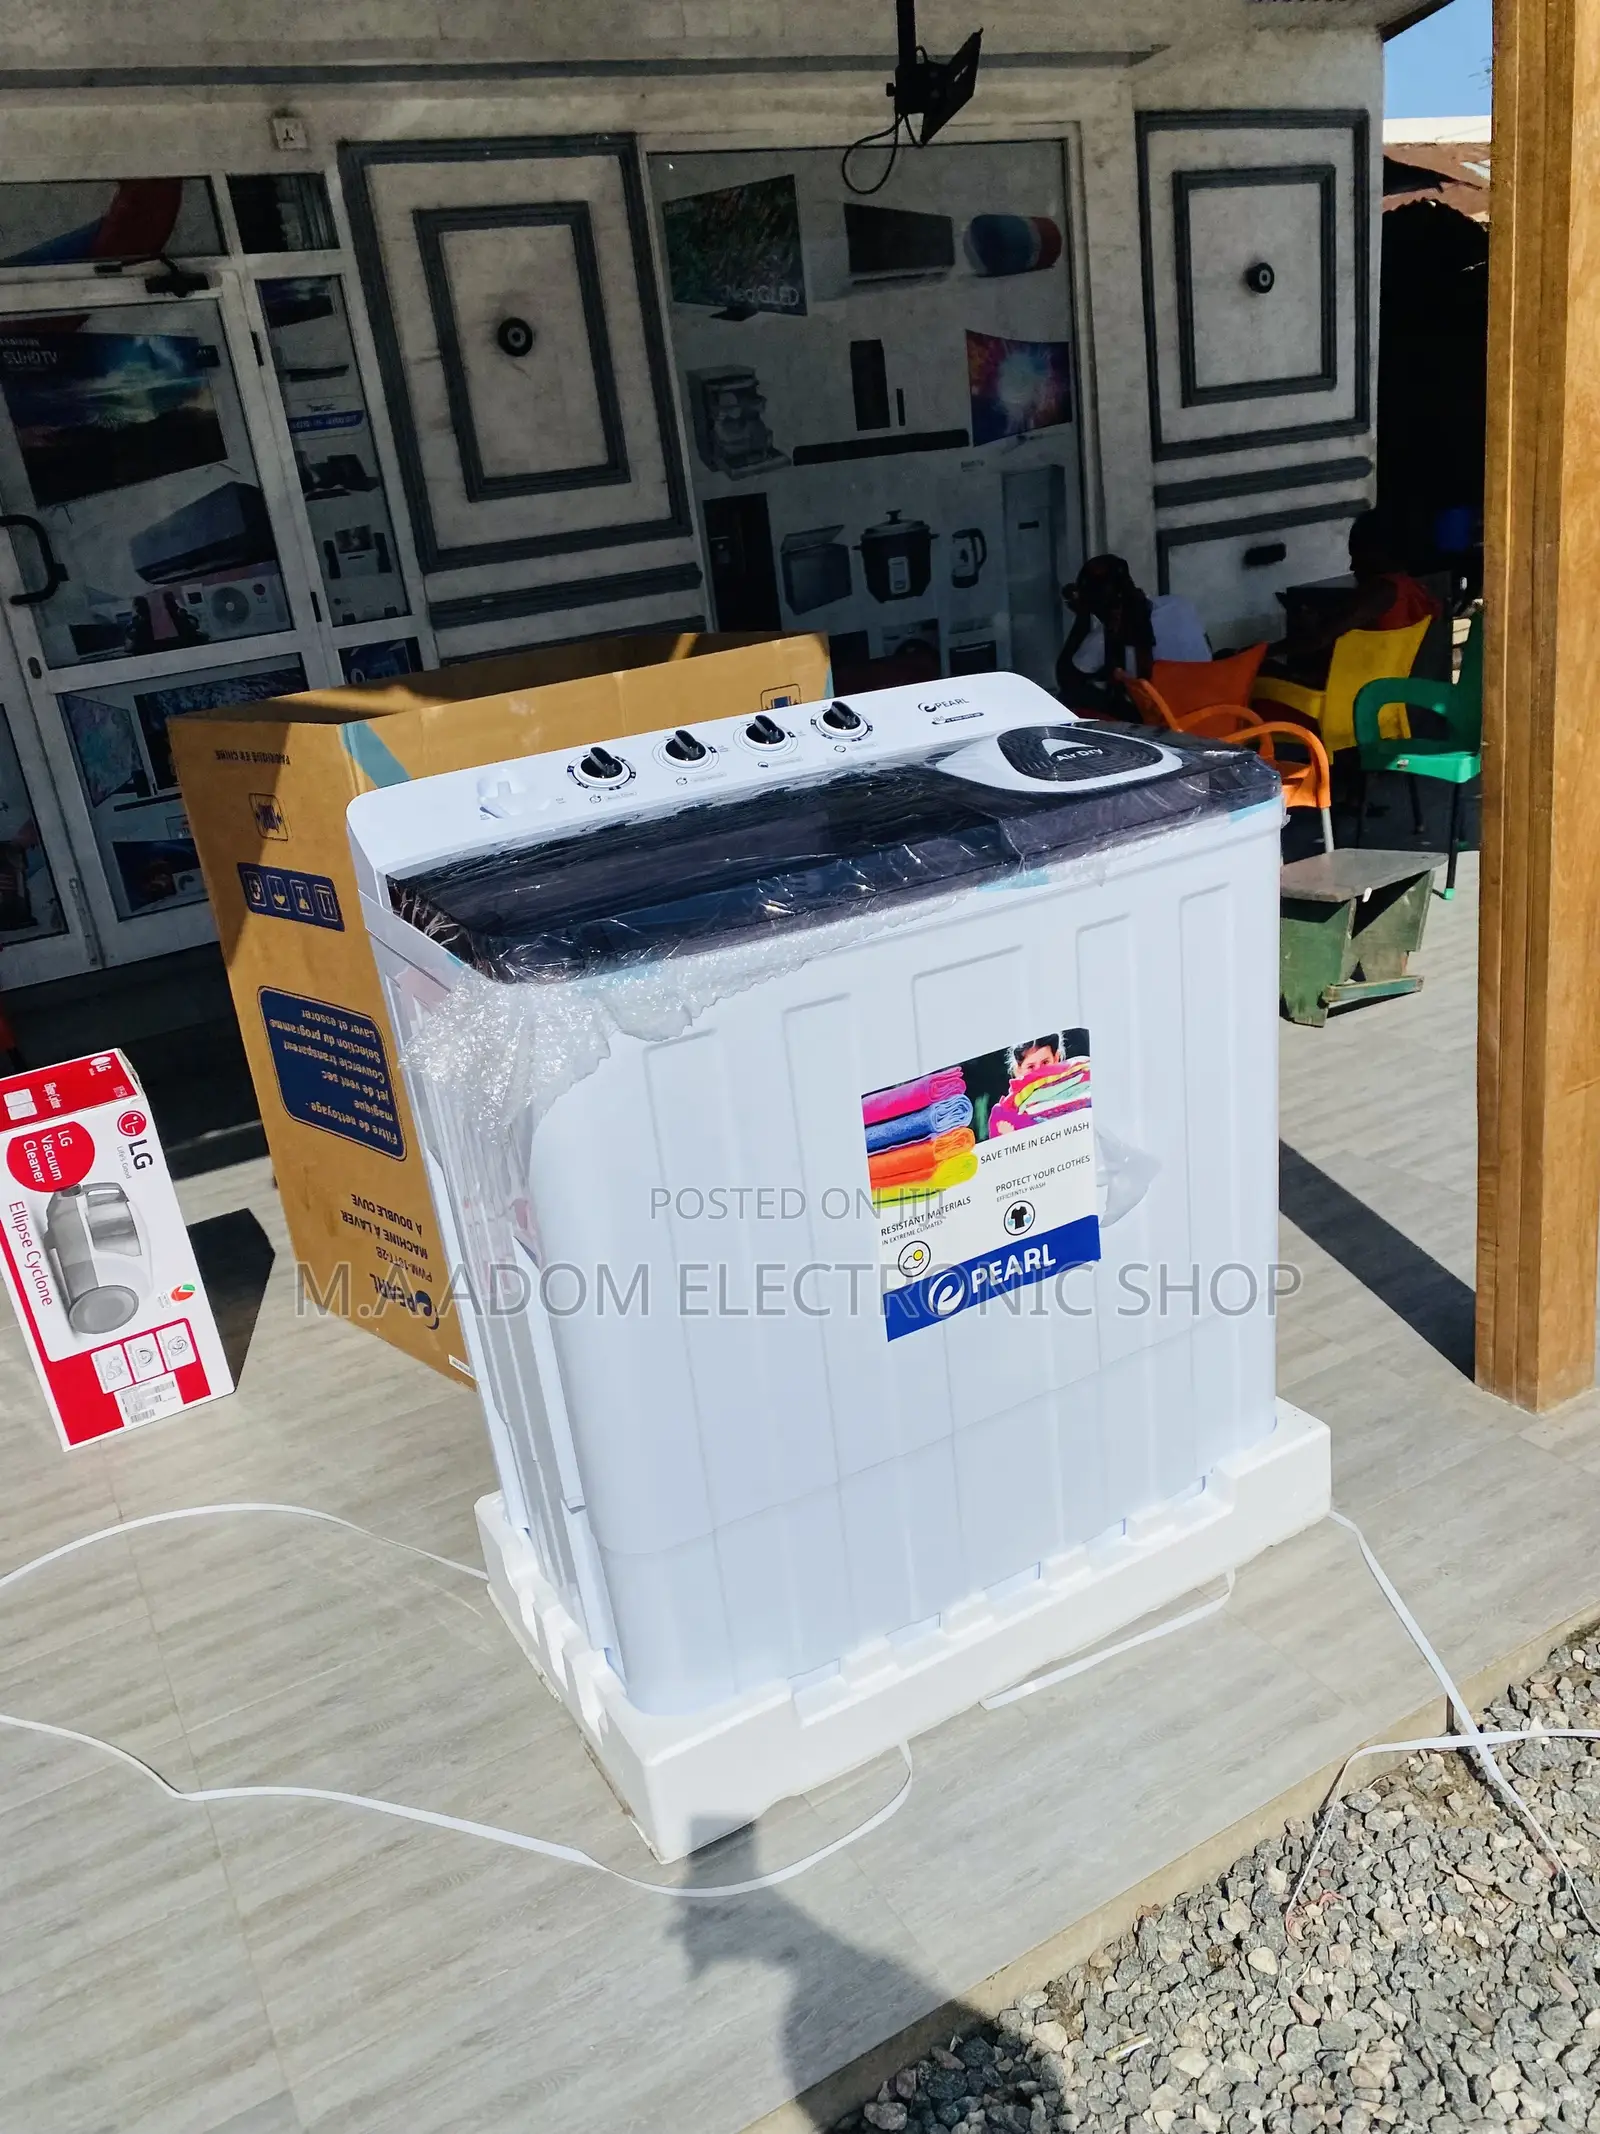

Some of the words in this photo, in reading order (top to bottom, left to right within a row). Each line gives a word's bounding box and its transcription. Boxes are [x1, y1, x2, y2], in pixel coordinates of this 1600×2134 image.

[935, 697, 970, 710] PEARL
[269, 1018, 321, 1041] programme
[339, 1021, 349, 1031] et
[351, 1024, 377, 1043] Laver
[323, 1033, 336, 1047] du
[283, 1040, 338, 1066] transparent
[321, 1070, 339, 1083] sec
[339, 1057, 385, 1084] Couvercle
[340, 1075, 361, 1091] vent
[362, 1084, 374, 1098] de
[311, 1101, 357, 1125] nettoyage
[353, 1100, 394, 1123] magique
[359, 1119, 370, 1133] de
[372, 1124, 398, 1145] Filtre
[57, 1130, 73, 1147] LG
[980, 1150, 1002, 1165] SAVE
[1004, 1143, 1026, 1156] TIME
[1027, 1139, 1038, 1148] IN
[1040, 1131, 1062, 1145] EACH
[1063, 1121, 1090, 1136] WASH
[23, 1140, 45, 1183] Cleaner
[41, 1135, 63, 1181] Vacuum
[116, 1145, 126, 1163] Life's
[121, 1162, 132, 1179] Good
[128, 1139, 154, 1170] LG
[995, 1174, 1031, 1193] PROTECT
[1033, 1167, 1055, 1182] YOUR
[1056, 1154, 1091, 1172] CLOTHES
[351, 1193, 375, 1213] CUVE
[996, 1187, 1028, 1203] EFFICIENTLY
[1029, 1181, 1047, 1193] WASH
[340, 1210, 372, 1234] LAVER
[378, 1204, 413, 1231] DOUBLE
[881, 1215, 925, 1236] RESISTANT
[927, 1196, 971, 1222] MATERIALS
[383, 1229, 428, 1260] MACHINE
[881, 1237, 889, 1246] IN
[889, 1228, 916, 1243] EXTREME
[916, 1219, 943, 1235] CLIMATES
[9, 1201, 33, 1248] Ellipse
[24, 1250, 53, 1306] Cyclone
[971, 1243, 1056, 1294] PEARL
[369, 1273, 417, 1313] PEARL
